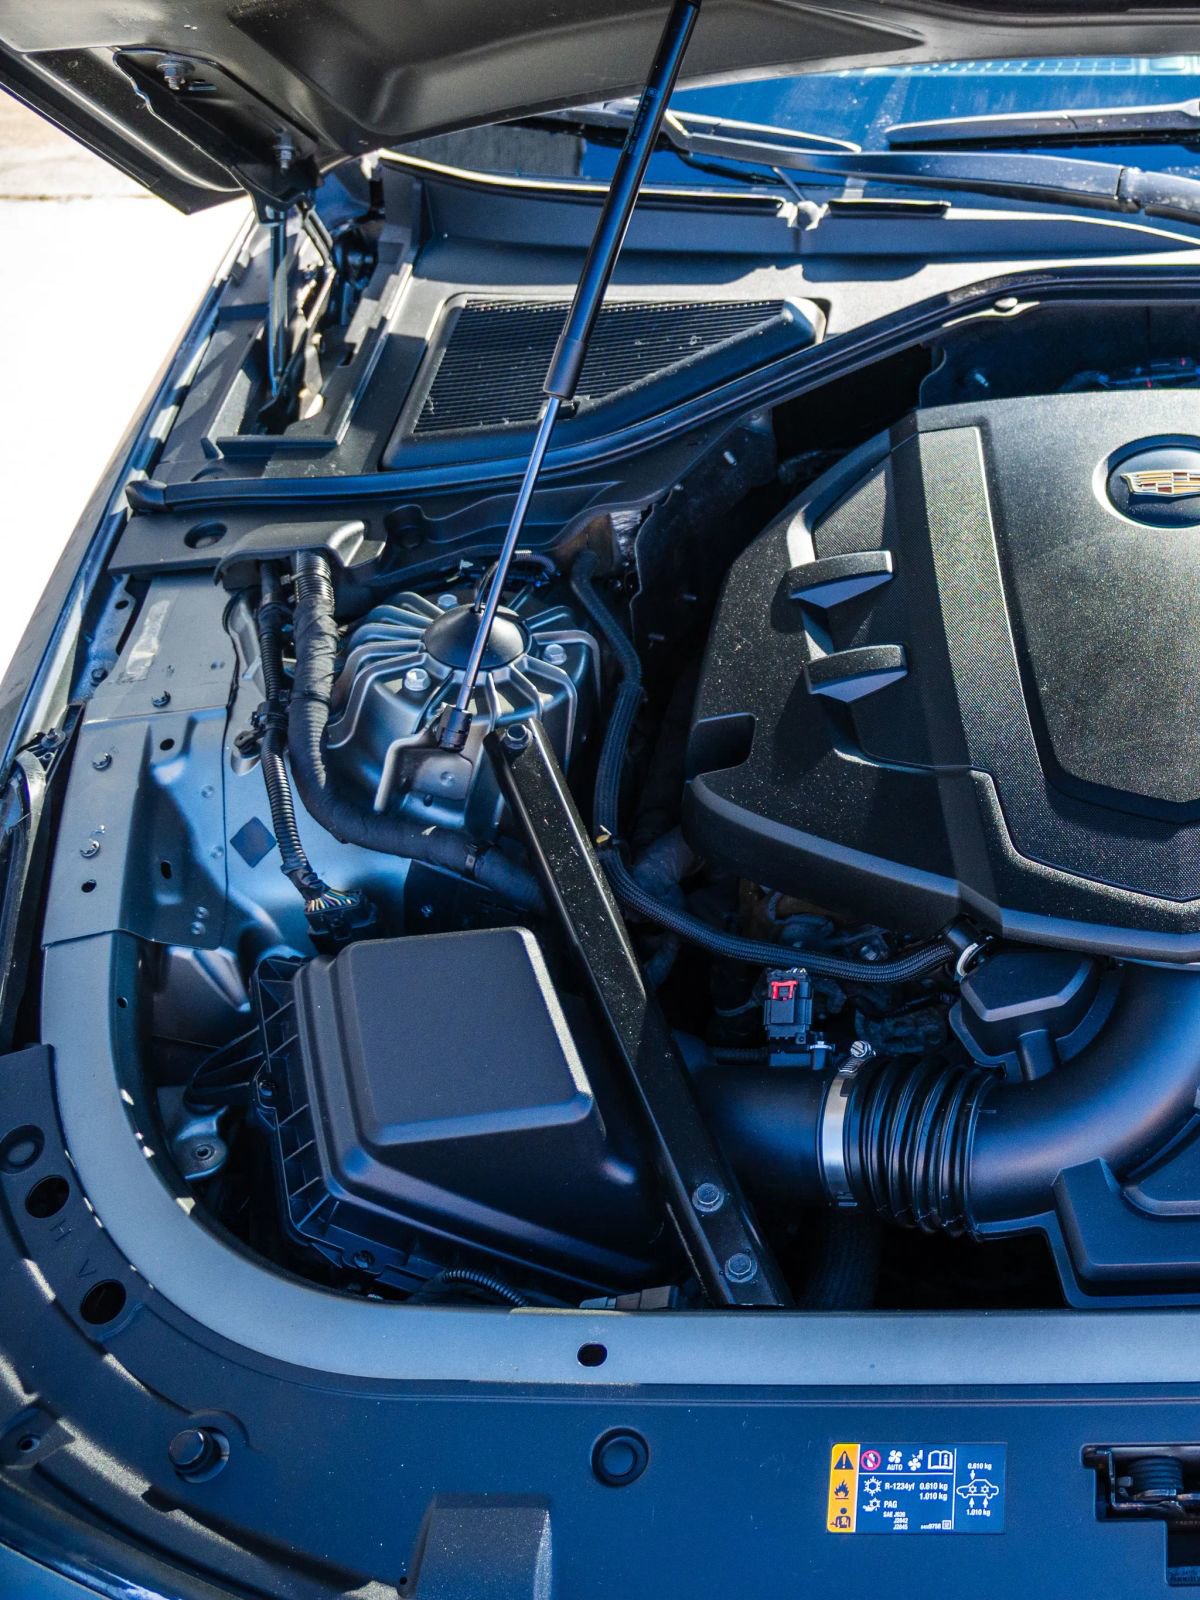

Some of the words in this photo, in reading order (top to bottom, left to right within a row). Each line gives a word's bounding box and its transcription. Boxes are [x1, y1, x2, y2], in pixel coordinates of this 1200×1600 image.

[884, 1482, 915, 1491] R-1234yf
[919, 1482, 938, 1490] 0.610
[939, 1482, 948, 1491] kg
[919, 1492, 938, 1500] 1.010
[938, 1492, 948, 1501] kg
[883, 1500, 898, 1508] PAG
[983, 1509, 991, 1517] kg
